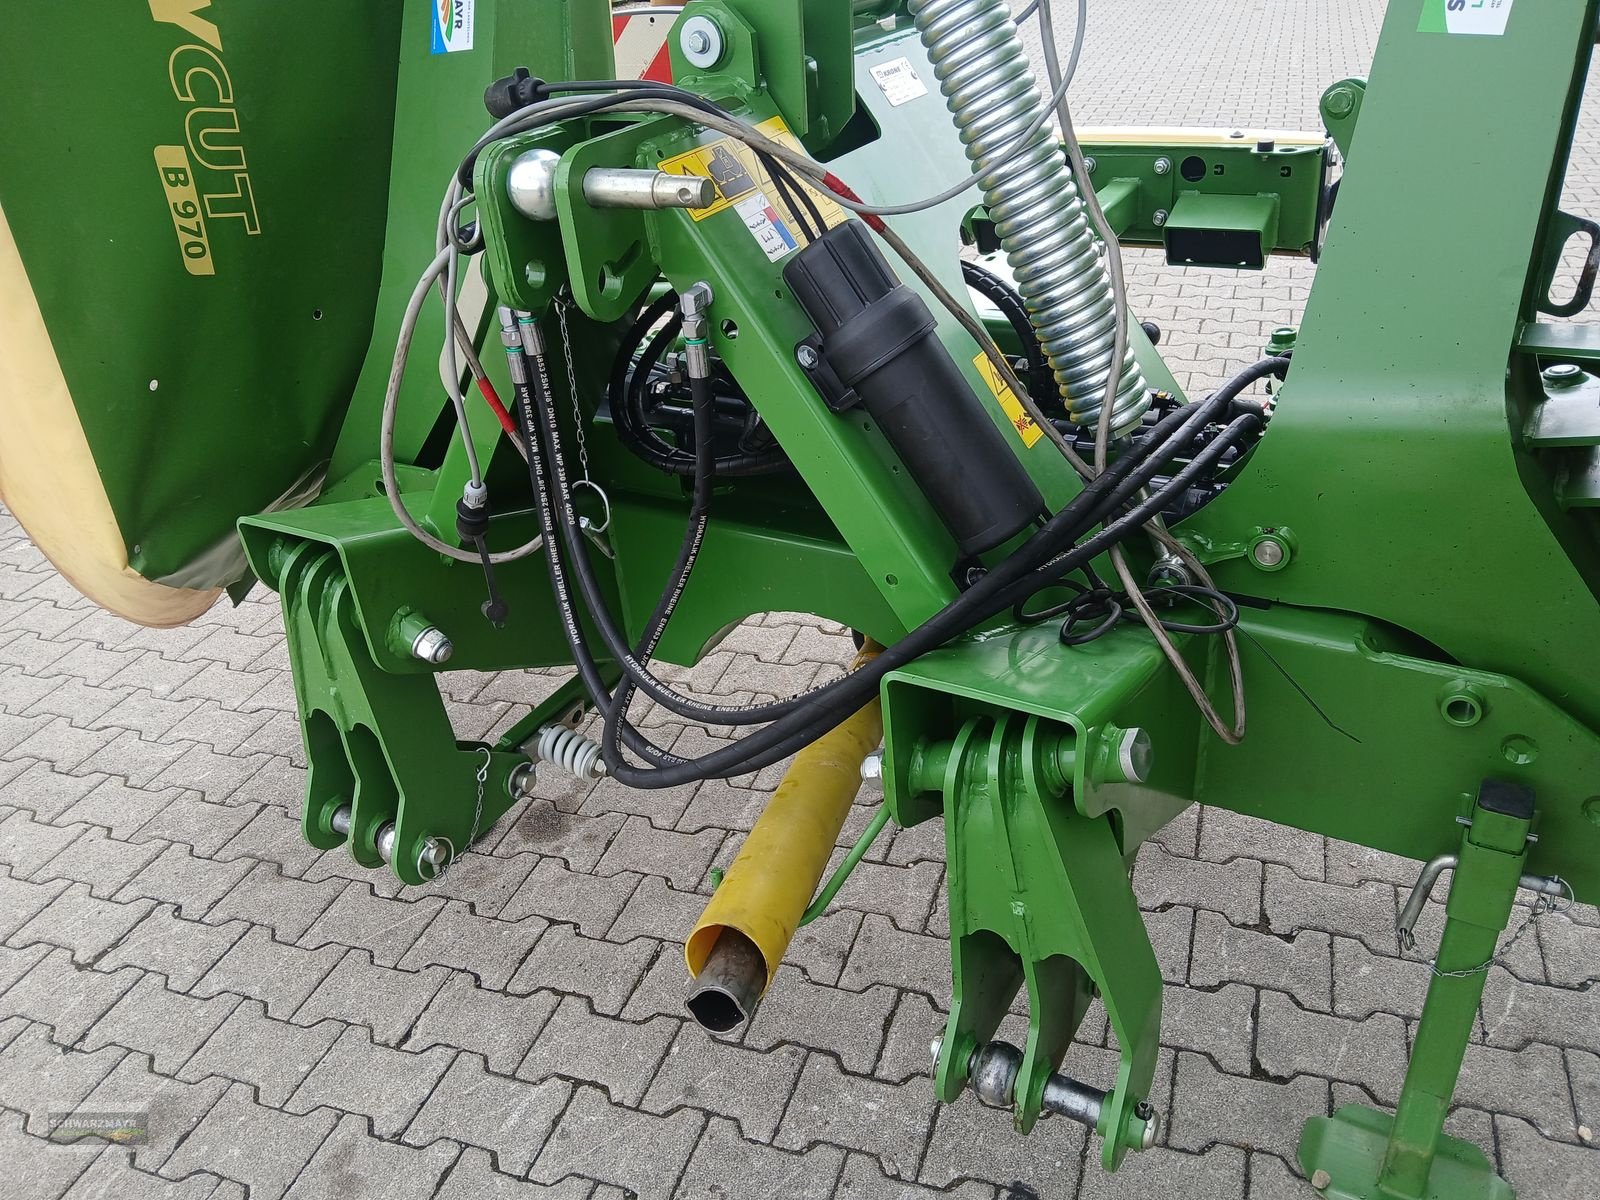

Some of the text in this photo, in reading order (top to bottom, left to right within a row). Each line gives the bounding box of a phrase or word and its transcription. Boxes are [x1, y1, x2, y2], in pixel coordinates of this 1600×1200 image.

[162, 167, 207, 260] B 970
[540, 373, 550, 389] 2SN
[521, 386, 530, 404] BAR
[524, 405, 533, 419] 330
[547, 407, 557, 428] DN10
[527, 420, 536, 433] WP
[533, 455, 543, 475] DN10
[555, 453, 564, 466] WP
[558, 467, 566, 481] 330
[540, 492, 549, 507] 2SN
[560, 482, 570, 500] BAR
[543, 508, 553, 531] EN853
[690, 515, 706, 554] HYDRAULIK
[547, 535, 559, 563] RHEINE
[678, 555, 695, 587] MUELLER
[554, 564, 568, 601] MUELLER
[664, 588, 681, 614] RHEINE
[562, 601, 581, 645] HYDRAULIK
[624, 655, 657, 687] HYDRAULIK
[655, 682, 689, 704] MUELLER
[686, 699, 713, 711] RHEINE
